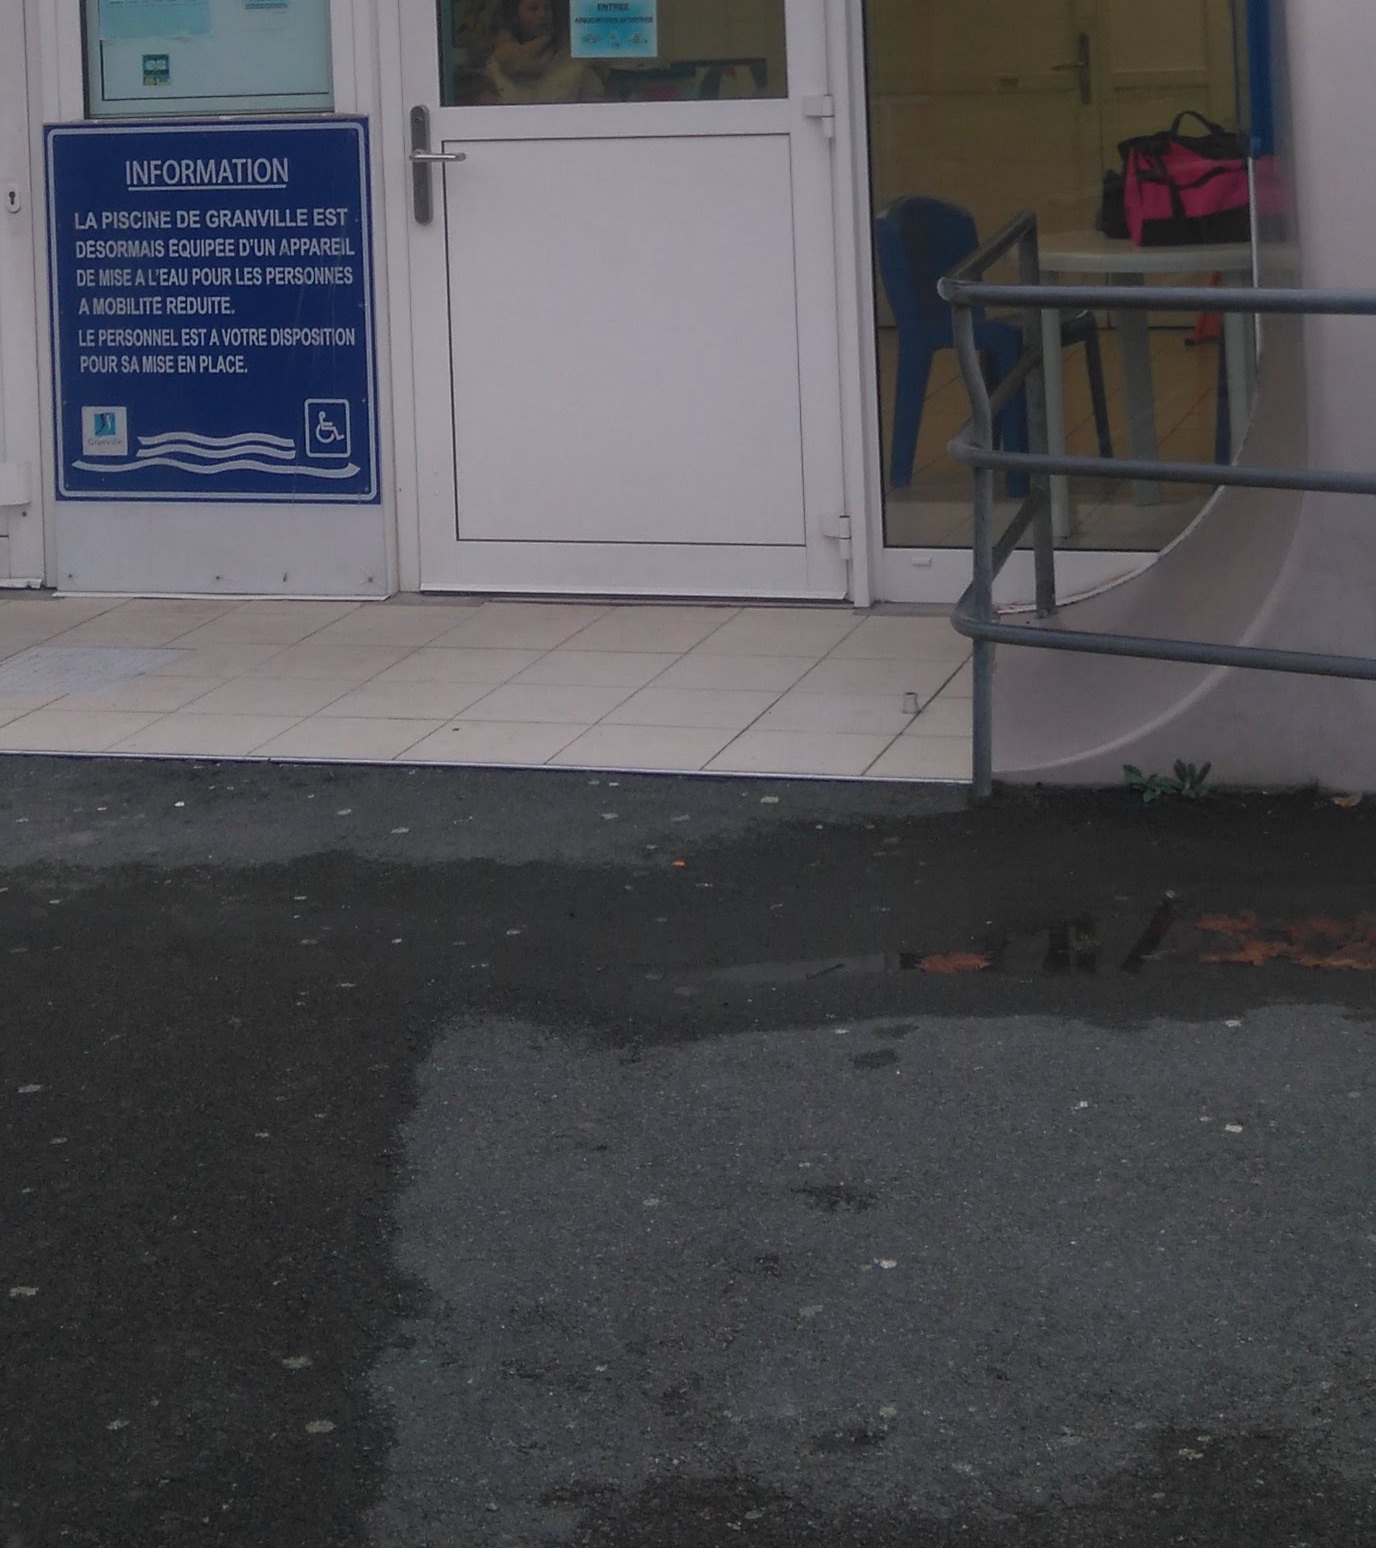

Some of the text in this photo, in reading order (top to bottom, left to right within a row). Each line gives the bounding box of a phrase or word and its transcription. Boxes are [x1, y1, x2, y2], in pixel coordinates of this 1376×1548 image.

[126, 158, 288, 185] INFORMATION
[75, 208, 348, 229] LA PISCINE DE GRANVILLE EST
[239, 238, 276, 257] D'UN
[279, 237, 355, 256] APPAREIL
[76, 268, 96, 287] DE
[99, 268, 132, 287] MISE
[149, 268, 188, 286] L'EAU
[192, 267, 232, 286] POUR
[236, 267, 262, 286] LES
[266, 266, 354, 285] PERSONNES
[78, 329, 96, 347] LE
[98, 328, 179, 347] PERSONNEL
[182, 328, 207, 346] EST
[222, 328, 268, 346] VOTRE
[270, 327, 356, 346] DISPOSITION
[80, 355, 248, 374] POUR SA MISE EN PLACE.
